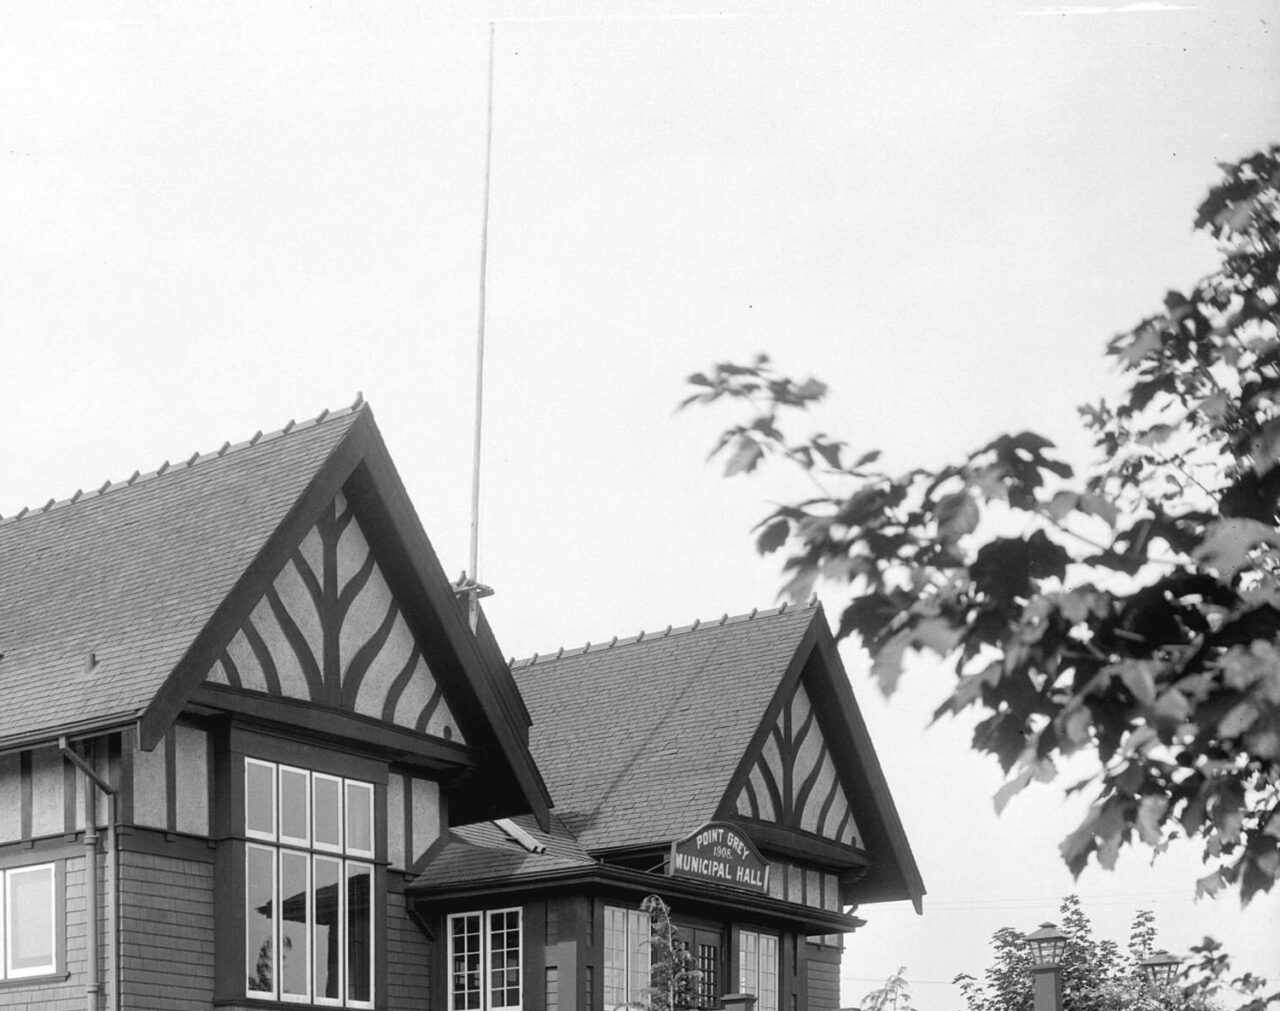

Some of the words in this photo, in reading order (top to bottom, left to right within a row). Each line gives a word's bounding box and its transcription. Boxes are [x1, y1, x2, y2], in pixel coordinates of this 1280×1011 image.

[696, 828, 724, 850] POINT
[727, 832, 749, 860] GREY
[675, 852, 732, 880] MUNICIPAL
[736, 866, 762, 886] HALL
